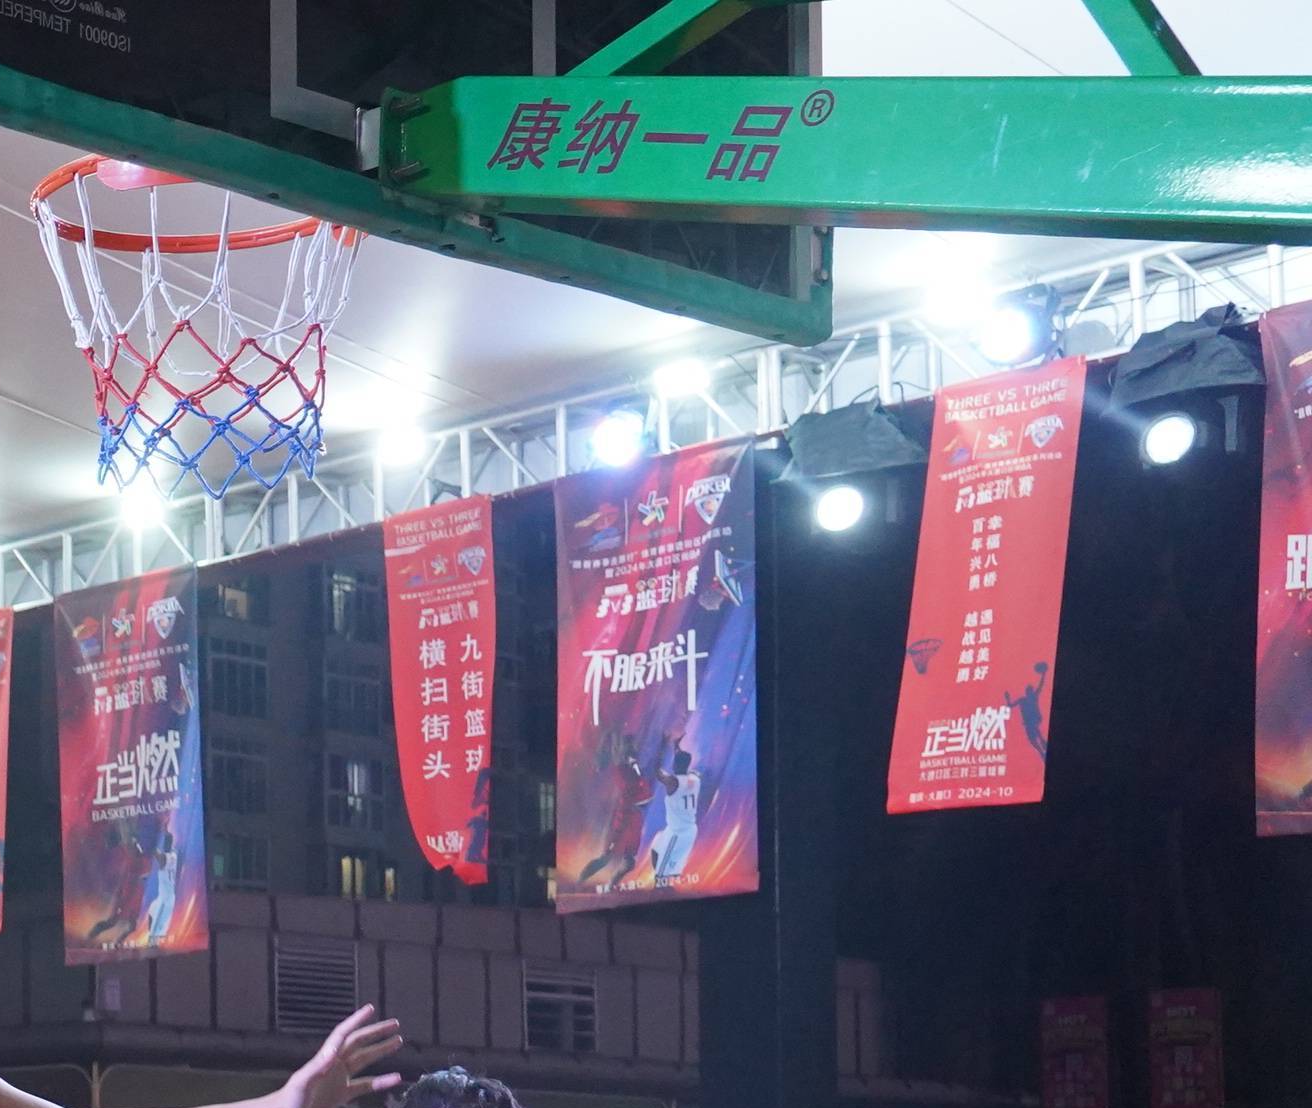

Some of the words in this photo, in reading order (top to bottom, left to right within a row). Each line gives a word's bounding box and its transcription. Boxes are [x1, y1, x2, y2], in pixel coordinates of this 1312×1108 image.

[945, 401, 1028, 424] BASKETBALL
[1030, 389, 1068, 408] GAME
[946, 392, 992, 411] THREE
[998, 387, 1017, 402] VS
[1024, 378, 1069, 396] THREE
[395, 520, 427, 535] THREE
[431, 516, 445, 529] VS
[448, 506, 481, 522] THREE
[396, 528, 455, 547] BASKETBALL
[456, 519, 483, 536] GAME
[582, 628, 709, 727] 不服来斗
[418, 638, 452, 781] 横扫街头
[459, 633, 487, 774] 九街篮球
[921, 705, 1011, 758] 正当燃
[92, 729, 181, 807] 正当燃
[919, 755, 977, 769] BASKETBALL
[978, 753, 1008, 764] GAME
[957, 786, 1014, 799] 2024-10
[91, 803, 155, 823] BASKETBALL
[155, 797, 181, 811] GAME
